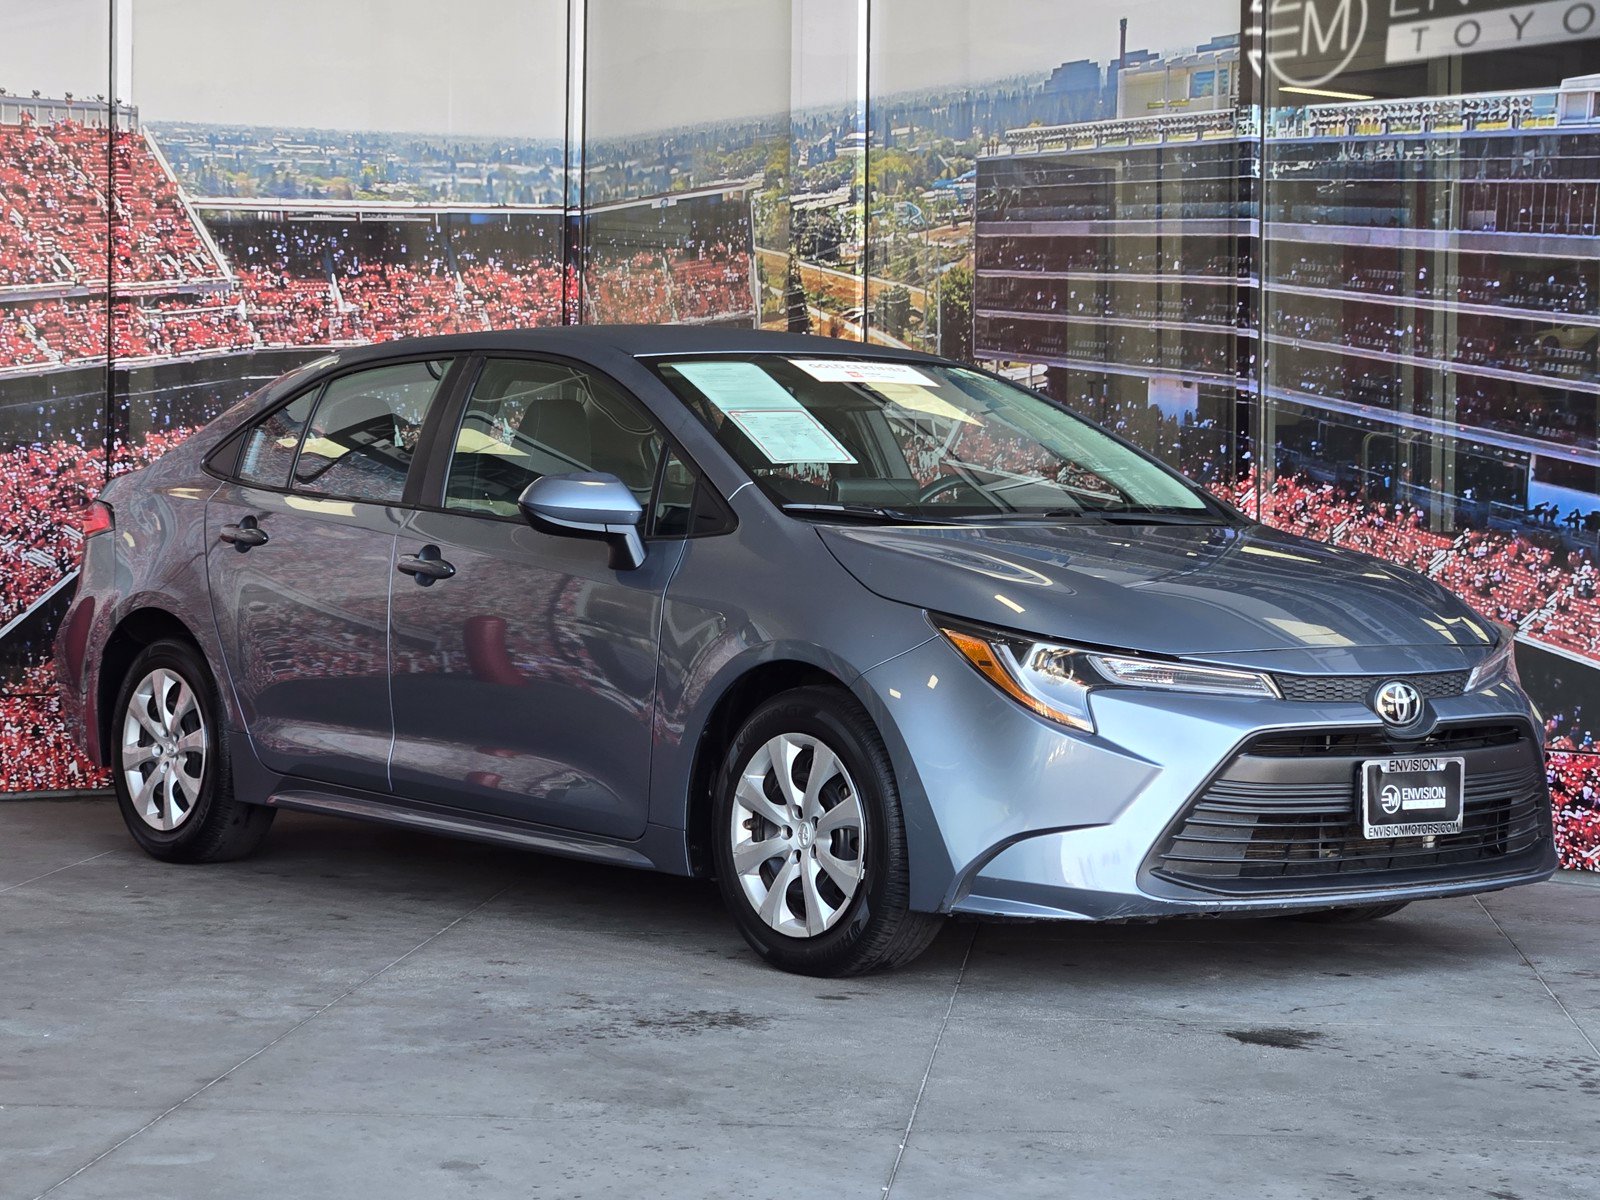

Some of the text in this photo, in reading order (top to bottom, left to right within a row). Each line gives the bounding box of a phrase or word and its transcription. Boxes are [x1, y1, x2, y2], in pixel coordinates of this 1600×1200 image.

[1389, 759, 1438, 772] ENVISION
[1402, 787, 1446, 799] ENVISION
[1368, 823, 1459, 837] ENVISIONMOTORS.COM
